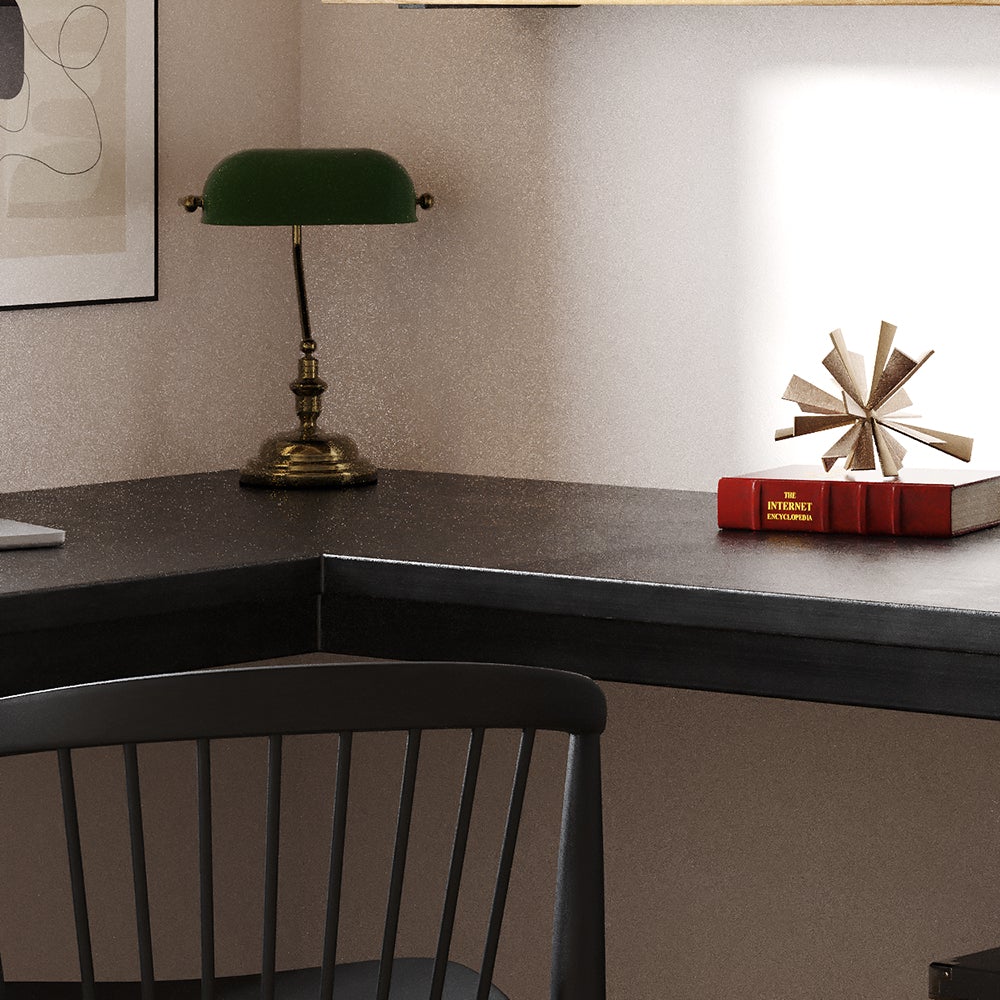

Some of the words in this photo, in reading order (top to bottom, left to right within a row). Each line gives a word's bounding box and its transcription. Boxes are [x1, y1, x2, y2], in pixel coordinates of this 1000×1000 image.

[783, 491, 797, 499] THE
[767, 501, 813, 512] INTERNET
[767, 513, 814, 522] ENCYCLOPEDIA
